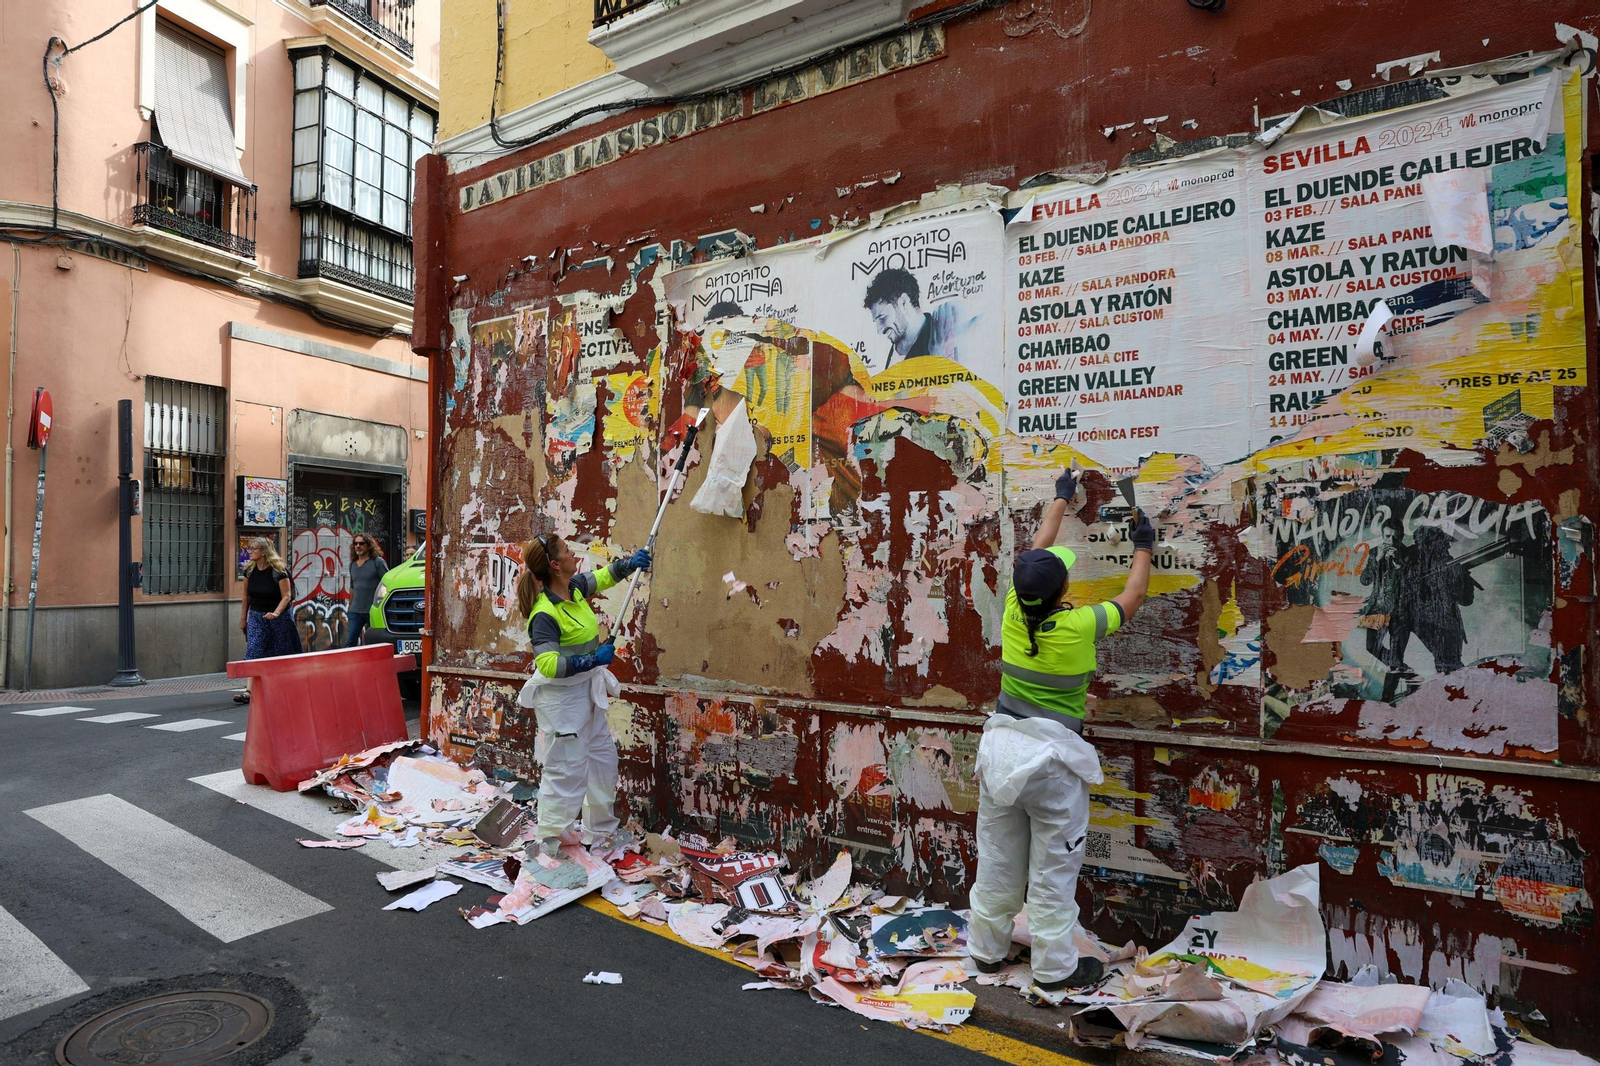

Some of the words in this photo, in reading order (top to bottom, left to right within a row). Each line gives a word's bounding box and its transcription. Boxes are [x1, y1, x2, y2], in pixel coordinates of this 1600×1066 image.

[1263, 136, 1372, 174] SEVILLA
[1379, 116, 1452, 150] 2024
[1479, 101, 1543, 123] monopro
[463, 153, 567, 211] JAVIER
[574, 109, 686, 171] LASSO
[1032, 194, 1101, 221] EVILLA
[1106, 180, 1162, 206] 2024
[1180, 168, 1235, 187] monoprod
[1265, 187, 1291, 209] EL
[1297, 165, 1395, 203] DUENDE
[1264, 211, 1282, 223] 03
[1286, 204, 1317, 220] FEB.
[1340, 193, 1381, 209] SALA
[1019, 236, 1039, 254] EL
[1044, 220, 1118, 249] DUENDE
[1123, 198, 1236, 235] CALLEJERO
[1266, 221, 1325, 249] KAZE
[869, 228, 950, 255] ANTOÑITO
[1018, 256, 1032, 266] 03
[1035, 252, 1059, 264] FEB.
[1077, 242, 1107, 256] SALA
[1110, 230, 1170, 250] PANDORA
[1266, 250, 1283, 263] 08
[1288, 244, 1324, 261] MAR.
[1348, 234, 1388, 250] SALA
[852, 241, 966, 281] MOLINA
[1267, 259, 1355, 290] ASTOLA
[1359, 255, 1376, 276] Y
[706, 265, 770, 289] ANTOÑITO
[1018, 290, 1032, 301] 08
[1035, 285, 1063, 299] MAR.
[1081, 278, 1112, 292] SALA
[1115, 268, 1176, 287] PANDORA
[1019, 266, 1065, 288] KAZE
[1267, 293, 1284, 305] 03
[1289, 287, 1322, 301] MAY.
[1346, 278, 1386, 294] SALA
[1390, 266, 1457, 288] CUSTOM
[692, 277, 782, 311] MOLINA
[1018, 299, 1087, 324] ASTOLA
[1090, 296, 1103, 314] Y
[1107, 284, 1172, 312] RATÓN
[1018, 327, 1032, 337] 03
[1035, 322, 1061, 335] MAY.
[1079, 315, 1110, 329] SALA
[1113, 308, 1163, 325] CUSTOM
[1268, 332, 1285, 345] 04
[1289, 328, 1324, 343] MAY.
[1347, 321, 1387, 336] SAA
[1391, 315, 1425, 331] CITE
[1018, 333, 1110, 360] CHAMBAO
[1269, 345, 1347, 371] GREEN
[1018, 363, 1032, 373] 04
[1035, 359, 1061, 371] MAY.
[1080, 354, 1110, 366] SALA
[1113, 350, 1139, 363] CITE
[871, 381, 895, 392] NES
[898, 372, 981, 390] ADMINISTRA
[1018, 374, 1079, 397] GREEN
[1084, 366, 1156, 390] VALLEY
[1269, 374, 1286, 387] 24
[1290, 370, 1324, 384] MAY.
[1441, 375, 1492, 389] ORES
[1557, 368, 1577, 380] 25
[1018, 399, 1032, 409] 24
[1035, 396, 1061, 408] MAY.
[1080, 391, 1110, 404] SALA
[1113, 385, 1183, 401] MALANDAR
[1270, 387, 1347, 413] RAU
[1018, 412, 1077, 433] RAULE
[1078, 427, 1126, 442] ICÓNICA
[1130, 426, 1159, 438] FEST
[1270, 416, 1287, 428] 14
[1291, 414, 1307, 427] JU
[1364, 426, 1414, 437] EDIO
